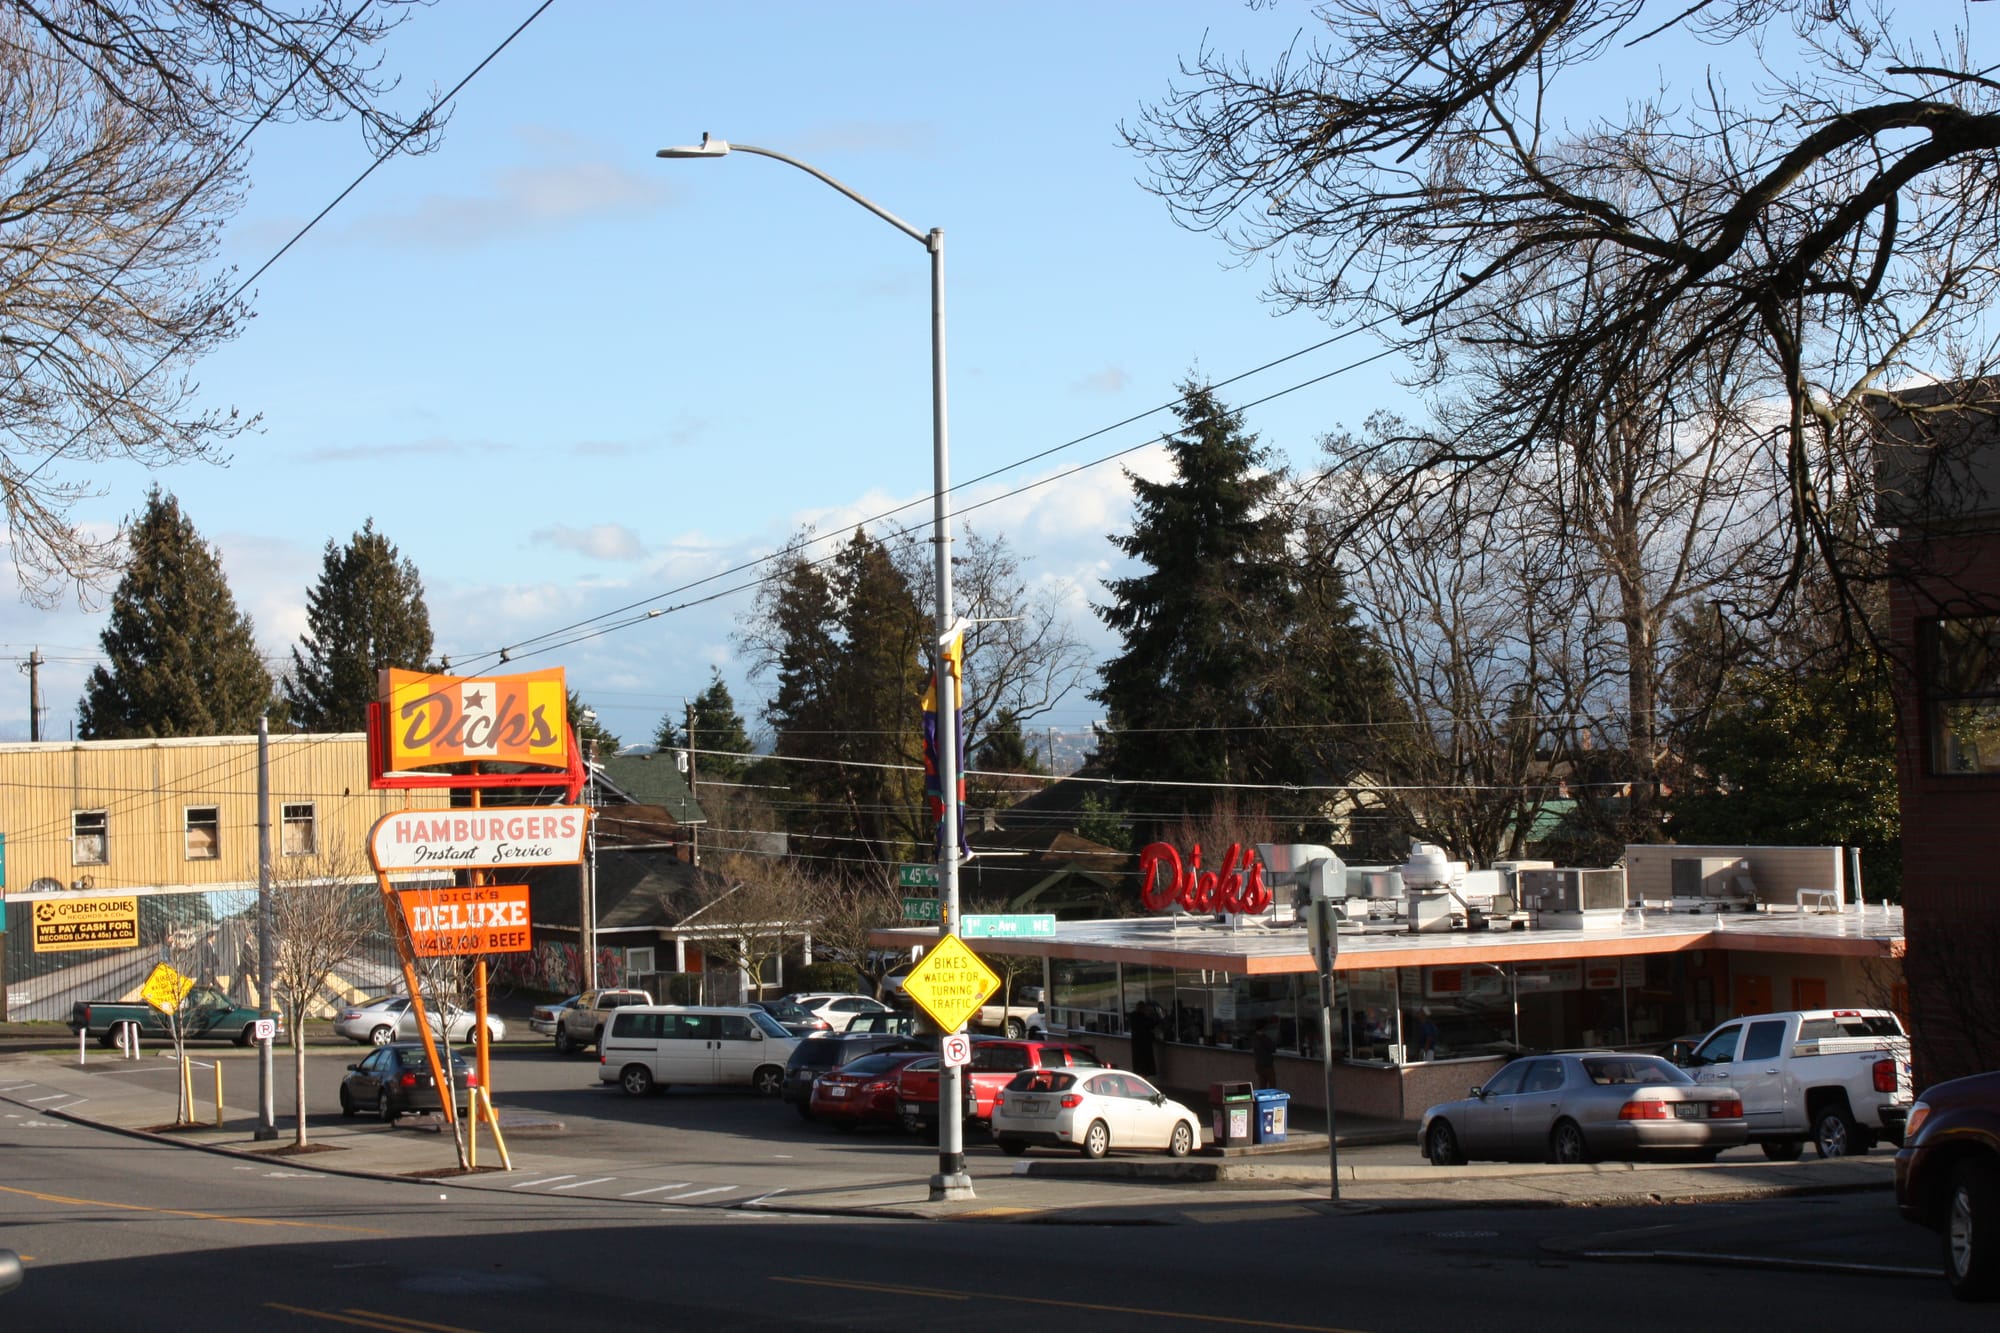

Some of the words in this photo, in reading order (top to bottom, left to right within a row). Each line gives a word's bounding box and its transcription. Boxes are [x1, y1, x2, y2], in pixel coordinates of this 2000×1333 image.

[395, 815, 576, 844] HAMBURGERS
[414, 844, 479, 865] Instant
[492, 843, 552, 863] Service
[1139, 841, 1273, 914] Dick's
[439, 890, 499, 902] DICK'S
[98, 901, 134, 912] OLDIES
[412, 900, 528, 932] DELUXE
[40, 924, 56, 934] WE
[58, 924, 77, 933] PAY
[79, 922, 106, 932] CASH
[109, 921, 132, 930] FOR:
[997, 920, 1017, 932] Ave
[1033, 919, 1050, 932] NE
[39, 934, 73, 942] RECORDS
[489, 932, 526, 947] BEEF
[934, 957, 968, 969] BIKES
[924, 973, 955, 982] WATCH
[960, 972, 980, 981] FOR
[931, 985, 973, 996] TURNING
[932, 999, 972, 1009] TRAFFIC
